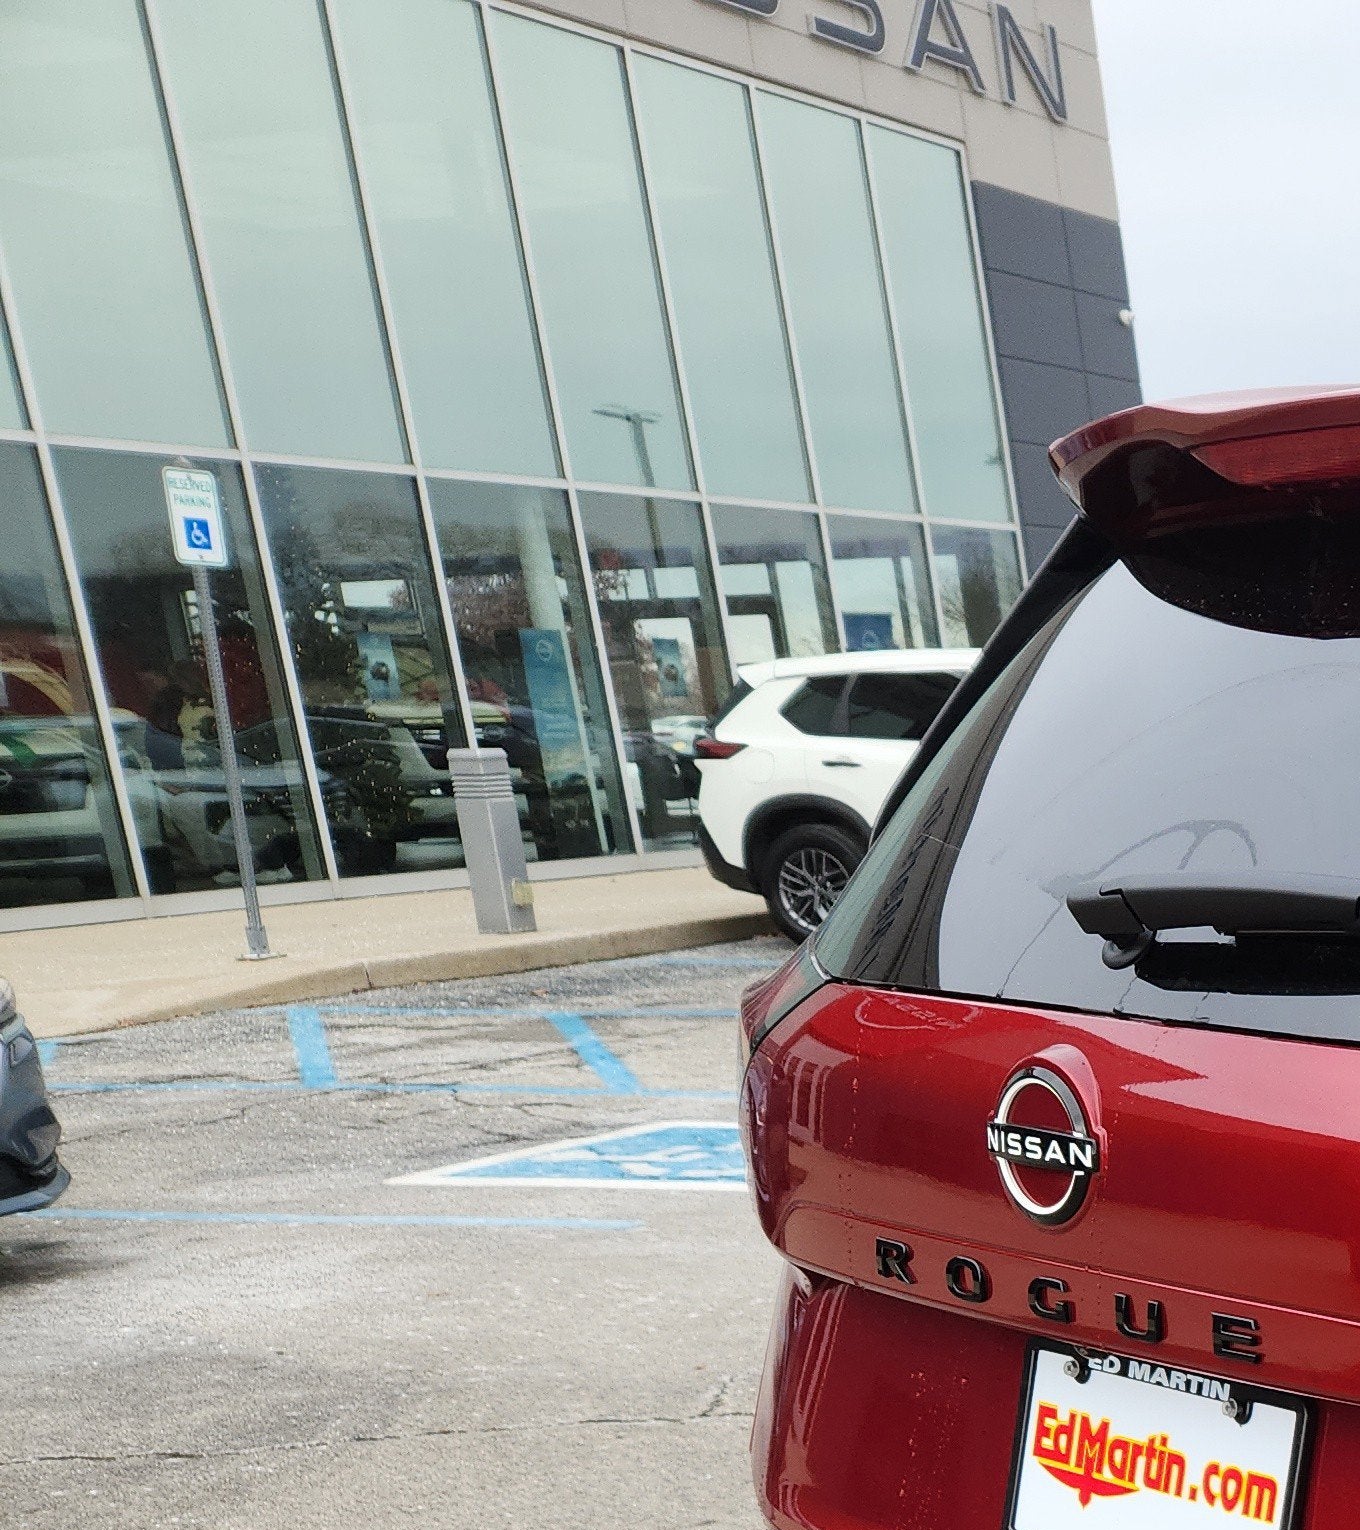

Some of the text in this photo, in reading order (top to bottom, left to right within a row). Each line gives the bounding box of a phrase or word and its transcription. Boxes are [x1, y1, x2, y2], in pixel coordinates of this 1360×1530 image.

[166, 477, 214, 493] RESERVED
[173, 493, 212, 509] PARKING
[986, 1126, 1093, 1168] NISSAN
[875, 1235, 1263, 1364] ROGUE
[1087, 1354, 1231, 1402] ED MARTIN
